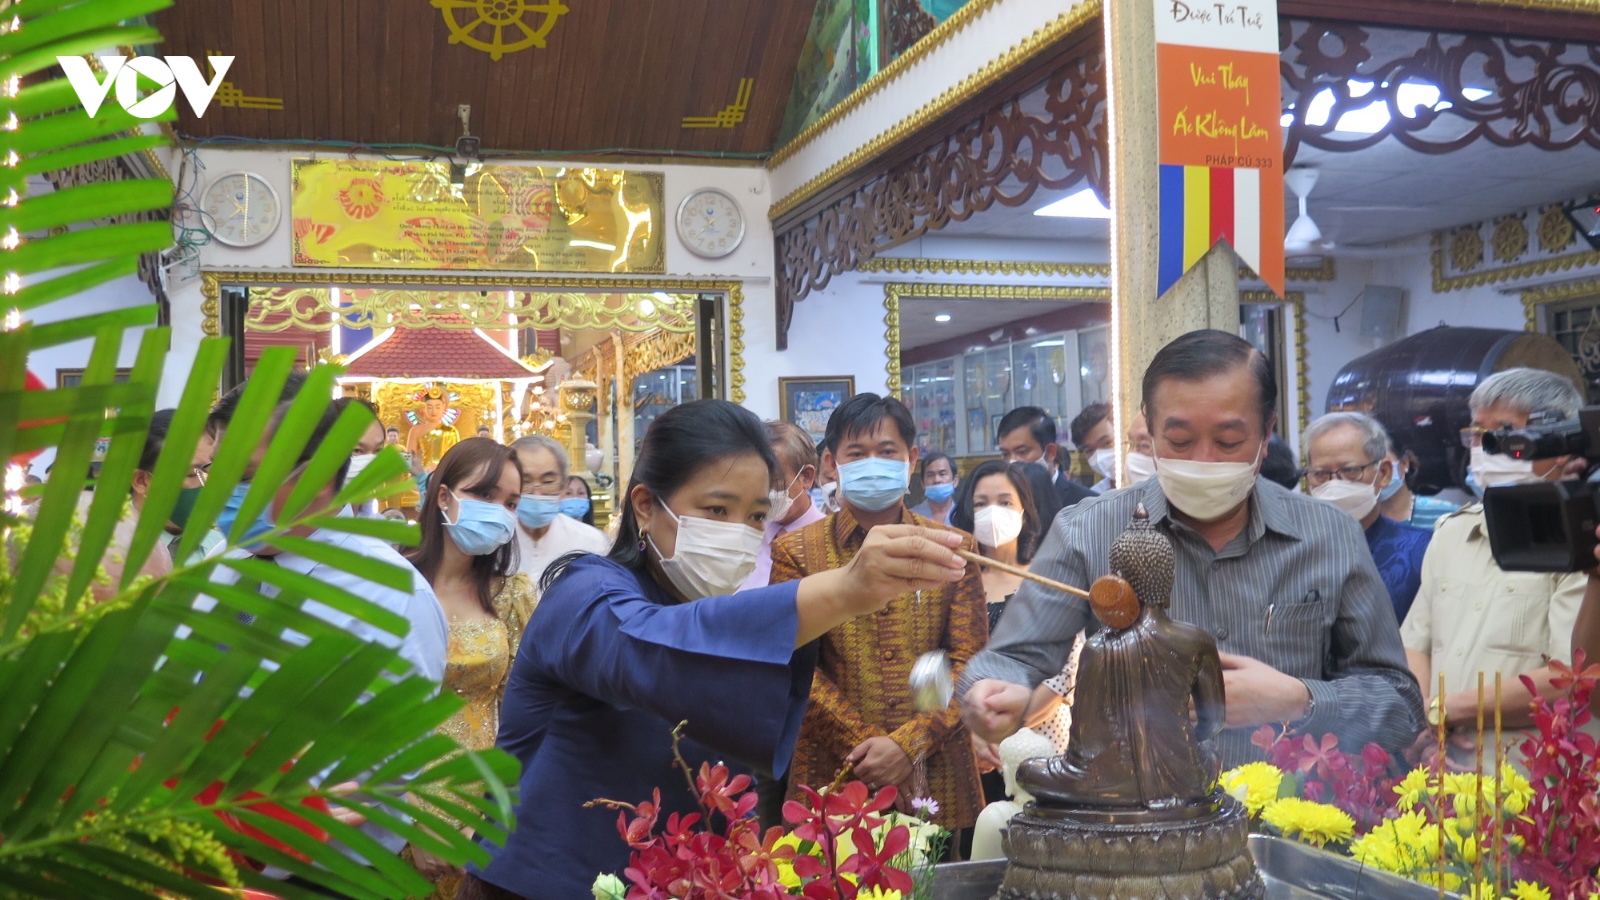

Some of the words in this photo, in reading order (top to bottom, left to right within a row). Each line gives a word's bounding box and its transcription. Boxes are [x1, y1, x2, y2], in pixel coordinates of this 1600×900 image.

[1170, 0, 1211, 24] Được
[1214, 4, 1234, 26] Trí
[1237, 6, 1262, 29] Tuệ
[1190, 62, 1216, 87] Vui
[1218, 62, 1249, 106] Thay
[1173, 106, 1193, 136] Ác
[1195, 109, 1238, 157] Không
[1241, 115, 1269, 142] Làm
[1205, 154, 1234, 167] PHÁP
